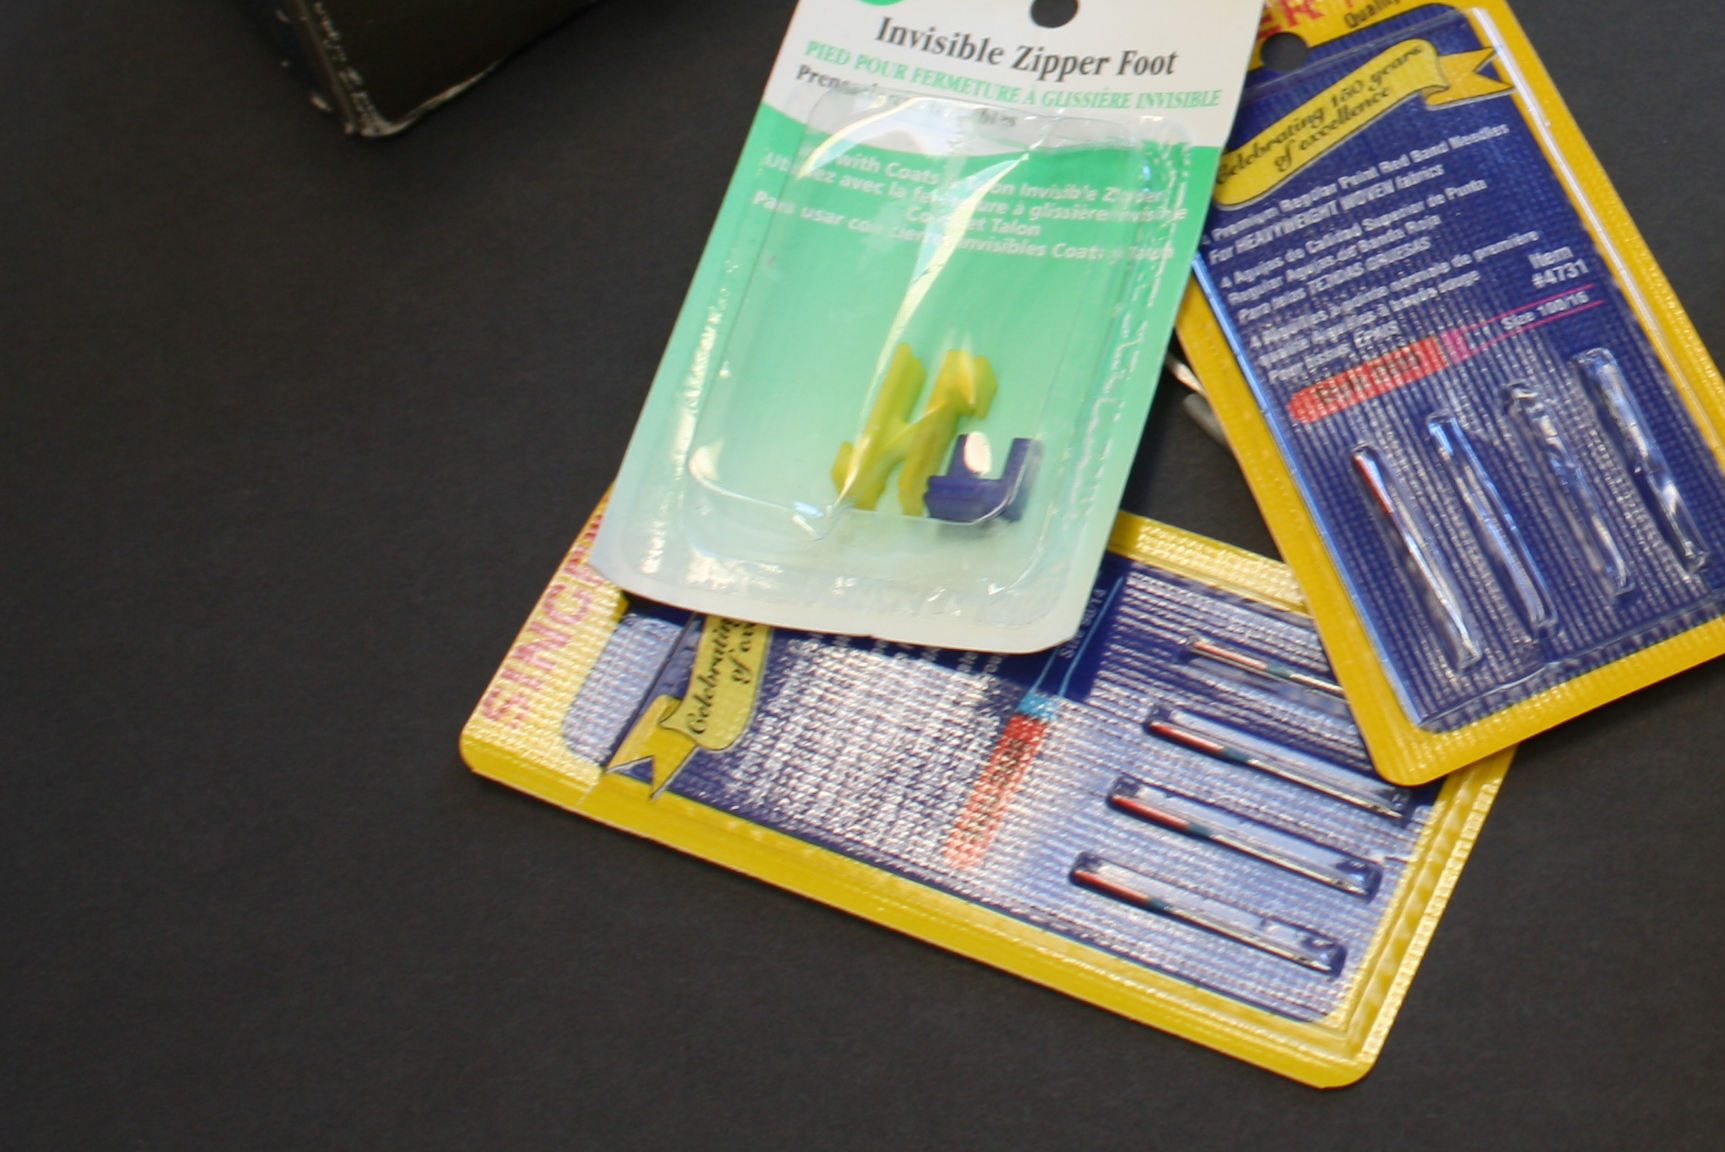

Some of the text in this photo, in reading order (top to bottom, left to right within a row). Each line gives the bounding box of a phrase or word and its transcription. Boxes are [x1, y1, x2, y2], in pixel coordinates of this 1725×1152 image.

[804, 40, 851, 65] PIED
[854, 52, 908, 80] POUR
[911, 65, 1020, 103] FERMETURE
[1041, 88, 1132, 109] GLISSIÈRE
[1136, 90, 1222, 108] INVISIBLE
[876, 17, 1178, 83] Invisible Zipper Foot
[1216, 45, 1424, 185] Celebrating 150 years
[1273, 89, 1391, 172] of excellence
[836, 150, 880, 173] with
[884, 159, 940, 185] Coats
[838, 173, 884, 194] avec
[888, 179, 908, 198] la
[1212, 206, 1278, 240] Premium
[1281, 182, 1337, 212] Regular
[1339, 167, 1377, 188] Point
[1379, 154, 1408, 173] Red
[1411, 141, 1447, 161] Band
[1450, 122, 1508, 147] Needles
[800, 205, 856, 229] usar
[989, 215, 1042, 237] Talon
[1209, 247, 1232, 263] For
[1234, 202, 1337, 252] HEAVYWEIGHT
[1395, 164, 1444, 188] fabrics
[1284, 245, 1306, 263] de
[1426, 190, 1447, 207] de
[1529, 246, 1571, 268] Item
[1532, 259, 1587, 288] #4731
[1501, 310, 1534, 329] Size
[483, 512, 604, 730] SING
